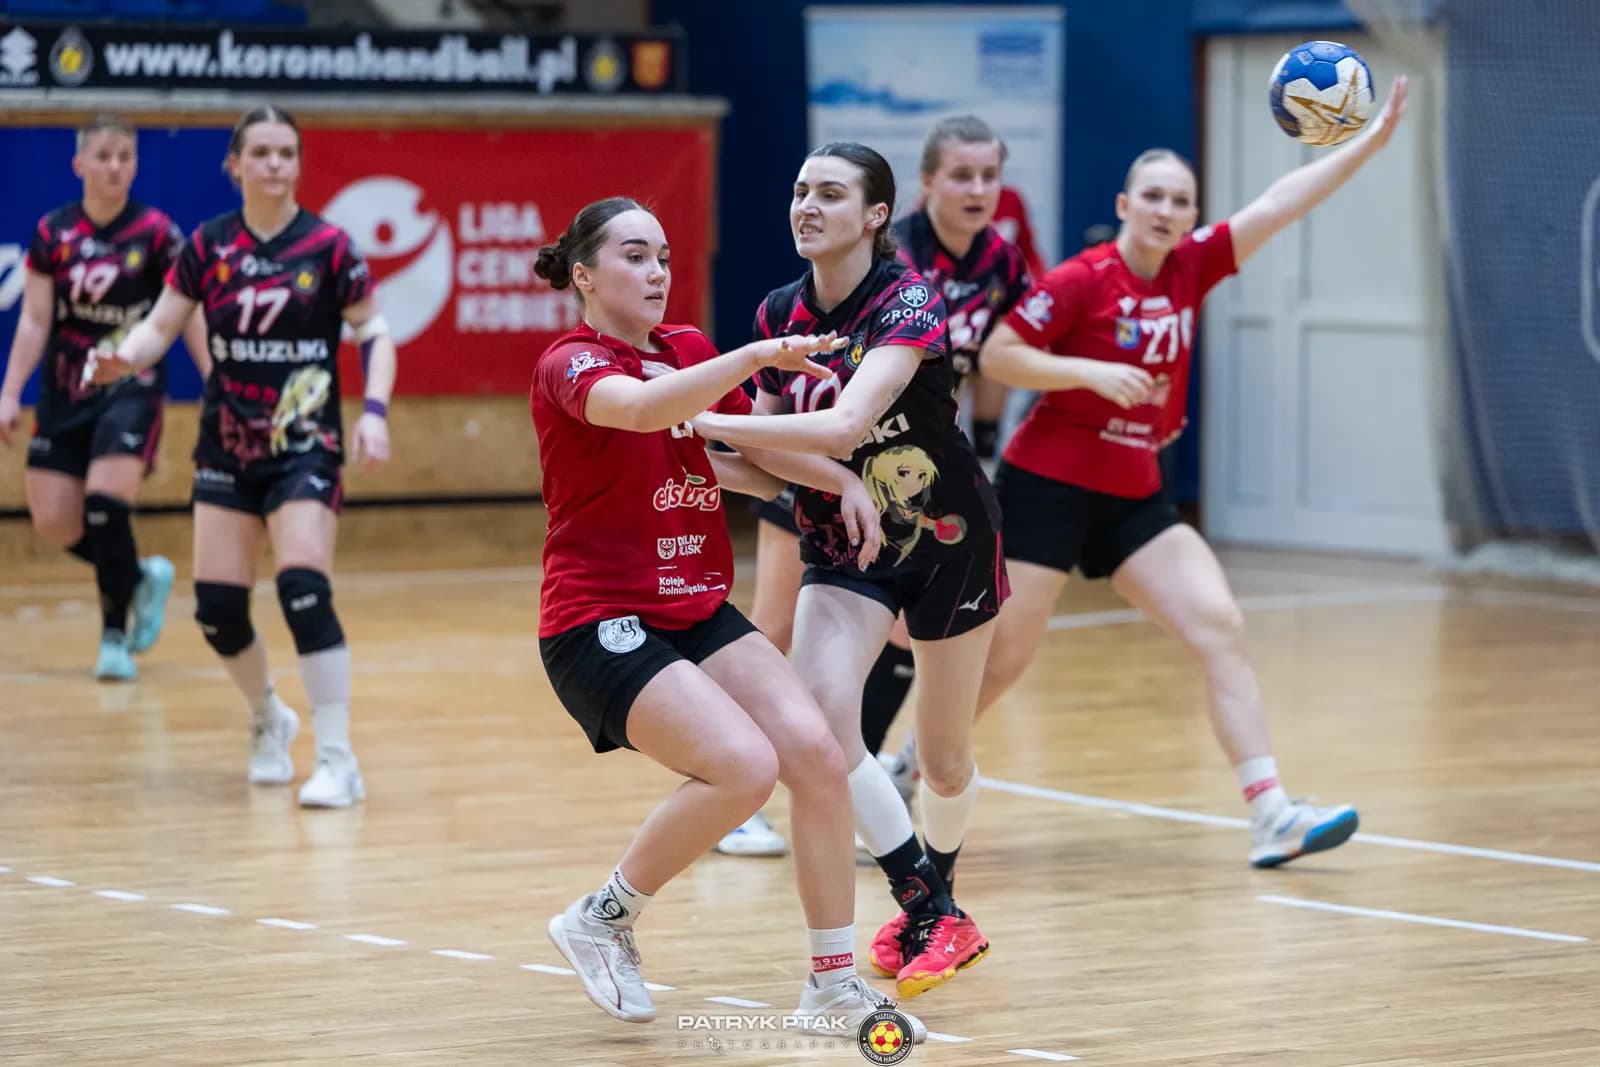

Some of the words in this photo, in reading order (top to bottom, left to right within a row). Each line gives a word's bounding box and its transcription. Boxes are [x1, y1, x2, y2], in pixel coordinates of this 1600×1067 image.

[105, 29, 577, 93] www.koronahandball.pl
[458, 202, 545, 243] LIGA
[69, 262, 120, 303] 19
[457, 249, 546, 287] CEN
[236, 286, 291, 335] 17
[230, 338, 329, 363] SUZUKI
[789, 372, 843, 414] 10
[659, 576, 685, 588] Koleje
